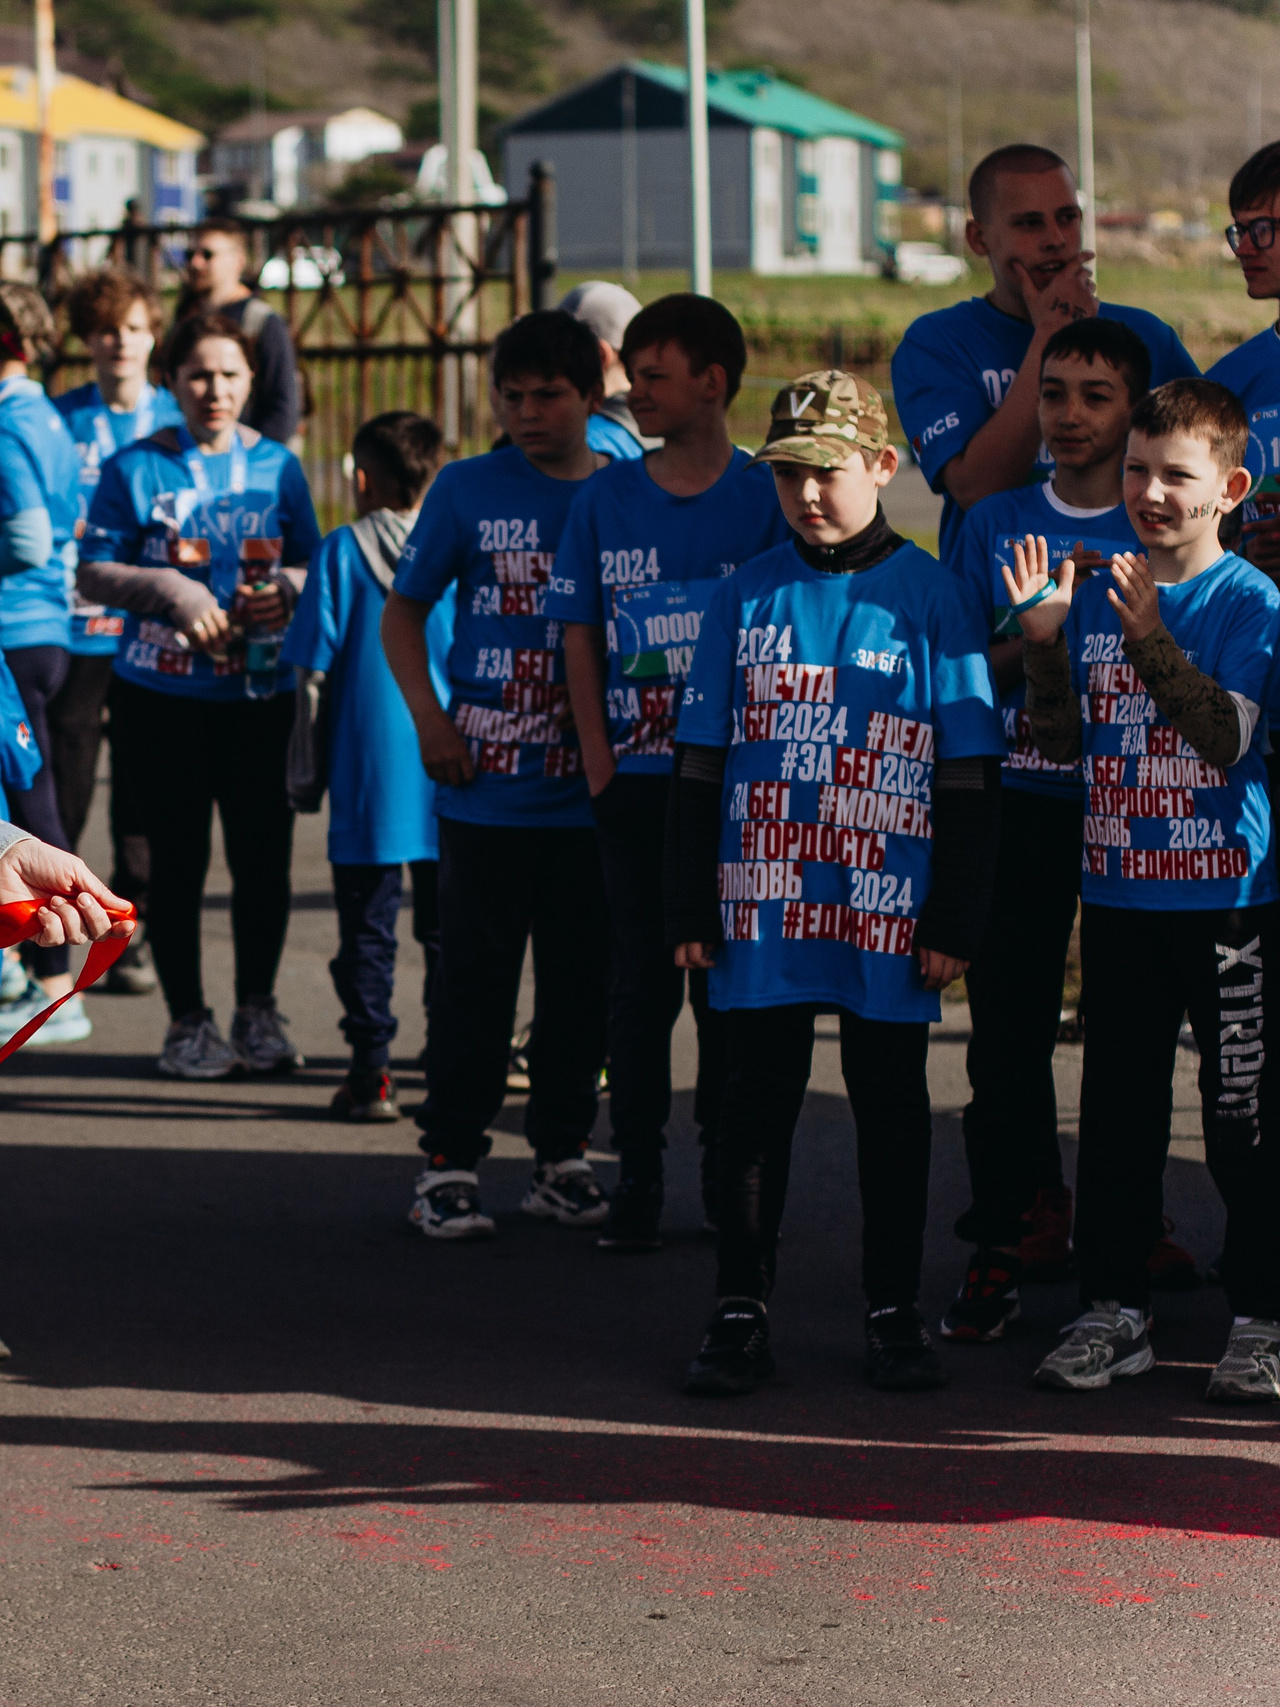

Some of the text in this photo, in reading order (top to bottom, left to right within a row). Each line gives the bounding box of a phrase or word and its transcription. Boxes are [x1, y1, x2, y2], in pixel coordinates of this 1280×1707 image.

[790, 391, 816, 418] V
[923, 411, 960, 445] ПСБ
[478, 518, 540, 551] 2024
[601, 547, 660, 585] 2024
[645, 610, 705, 647] 1000
[736, 624, 792, 666] 2024
[476, 648, 554, 682] #ЗАБЕГ
[856, 648, 904, 673] ЗА БЕГ
[744, 663, 838, 703] #МЕЧТА
[1089, 786, 1196, 818] #ГОРДОСТЬ
[741, 821, 887, 872] #ГОРДОСТЬ
[1169, 818, 1226, 850] 2024
[1121, 847, 1249, 880] #ЕДИНСТВО
[850, 869, 913, 915] 2024
[782, 901, 918, 956] #ЕДИНСТВ
